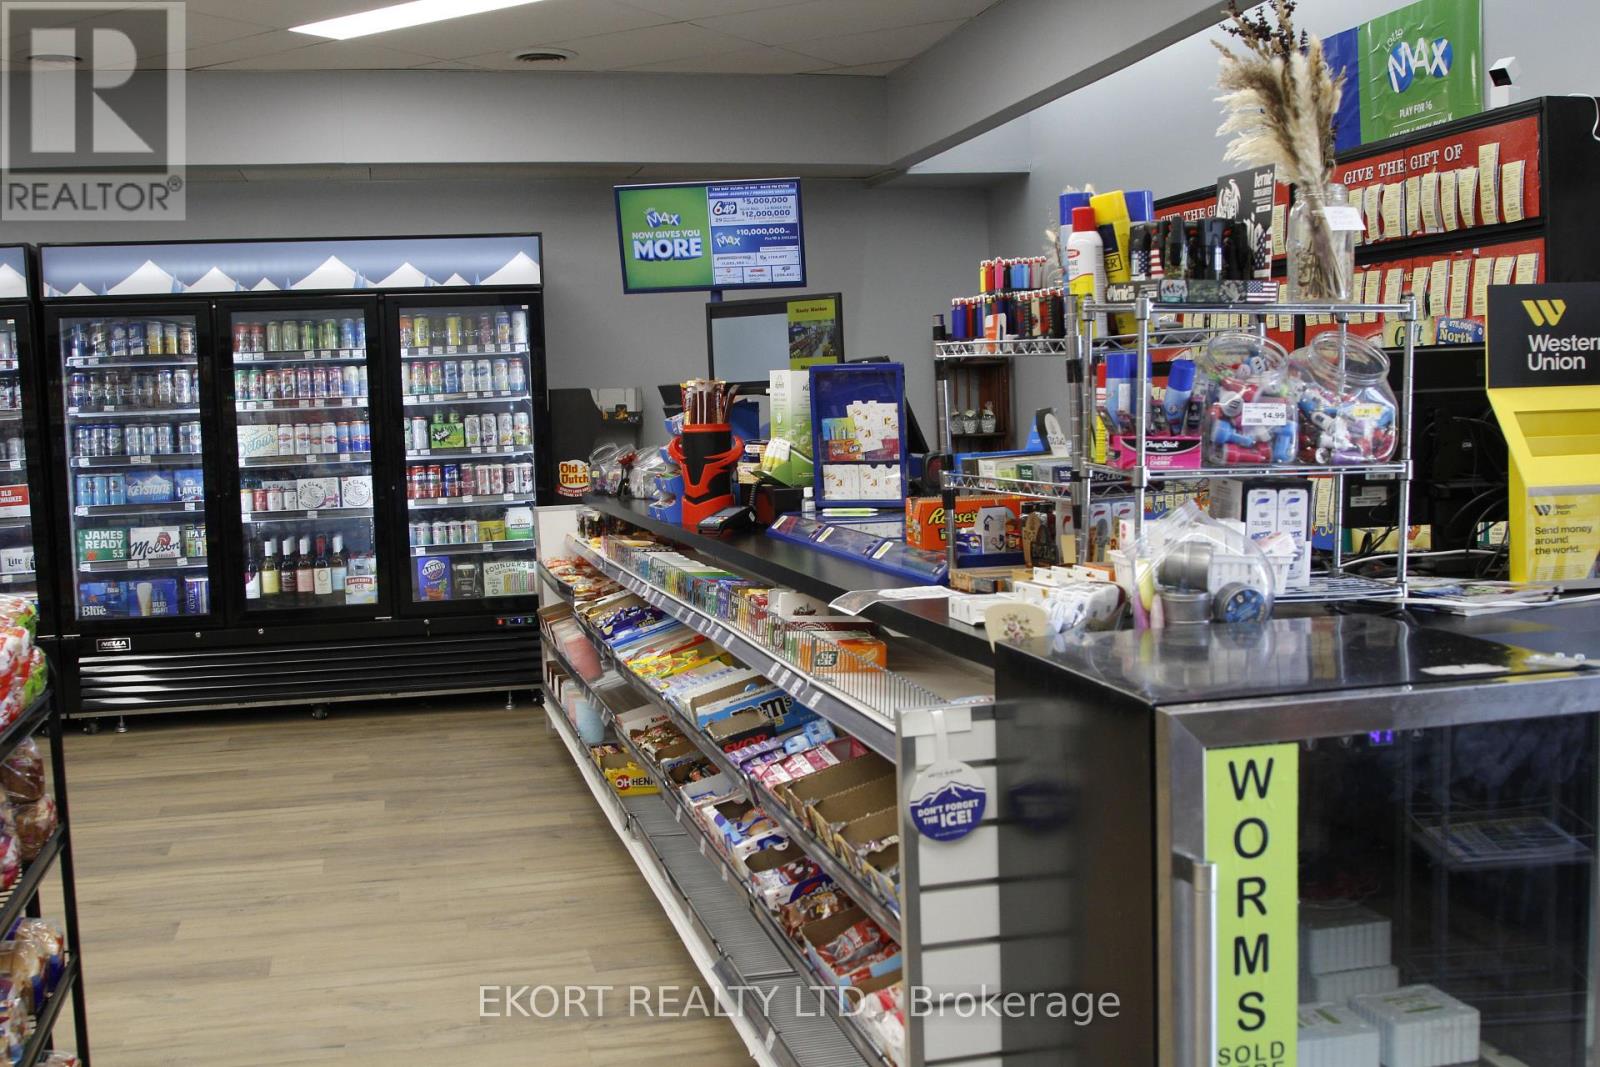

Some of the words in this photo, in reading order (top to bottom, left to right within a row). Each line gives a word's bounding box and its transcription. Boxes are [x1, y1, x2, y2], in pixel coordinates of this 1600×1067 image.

[1388, 37, 1449, 93] MAX
[1400, 106, 1414, 118] PLAY
[1414, 102, 1425, 114] FOR
[1343, 165, 1374, 185] GIVE
[1378, 158, 1407, 177] THE
[1410, 151, 1440, 169] GIFT
[1444, 144, 1463, 162] OF
[646, 211, 681, 228] MAX
[1183, 207, 1206, 222] THE
[632, 231, 654, 240] NOW
[655, 230, 681, 238] GIVES
[681, 229, 701, 237] YOU
[736, 228, 785, 236] $10,000,000
[633, 238, 702, 261] MORE
[1440, 328, 1473, 344] North
[1528, 354, 1586, 371] Union
[560, 463, 578, 473] Old
[561, 474, 589, 484] Dutch
[127, 482, 172, 497] KEYSTONE
[178, 485, 203, 497] LAKER
[928, 507, 978, 525] Rese's
[85, 530, 124, 540] JAMES
[1535, 526, 1559, 535] Send
[1560, 526, 1592, 534] money
[85, 540, 124, 550] READY
[1535, 536, 1569, 545] around
[112, 549, 124, 559] 5.5
[131, 540, 180, 560] Molson
[1535, 546, 1551, 555] the
[485, 561, 527, 575] FOUNDERS
[81, 605, 107, 617] Blue
[100, 640, 127, 648] NELLA
[616, 778, 631, 788] OH
[632, 776, 653, 786] HEN
[917, 804, 944, 818] DON'T
[945, 799, 979, 813] FORGET
[923, 815, 939, 826] THE
[940, 809, 973, 828] ICE!
[1228, 757, 1275, 1033] WORMS
[1218, 1041, 1285, 1067] SOLD
